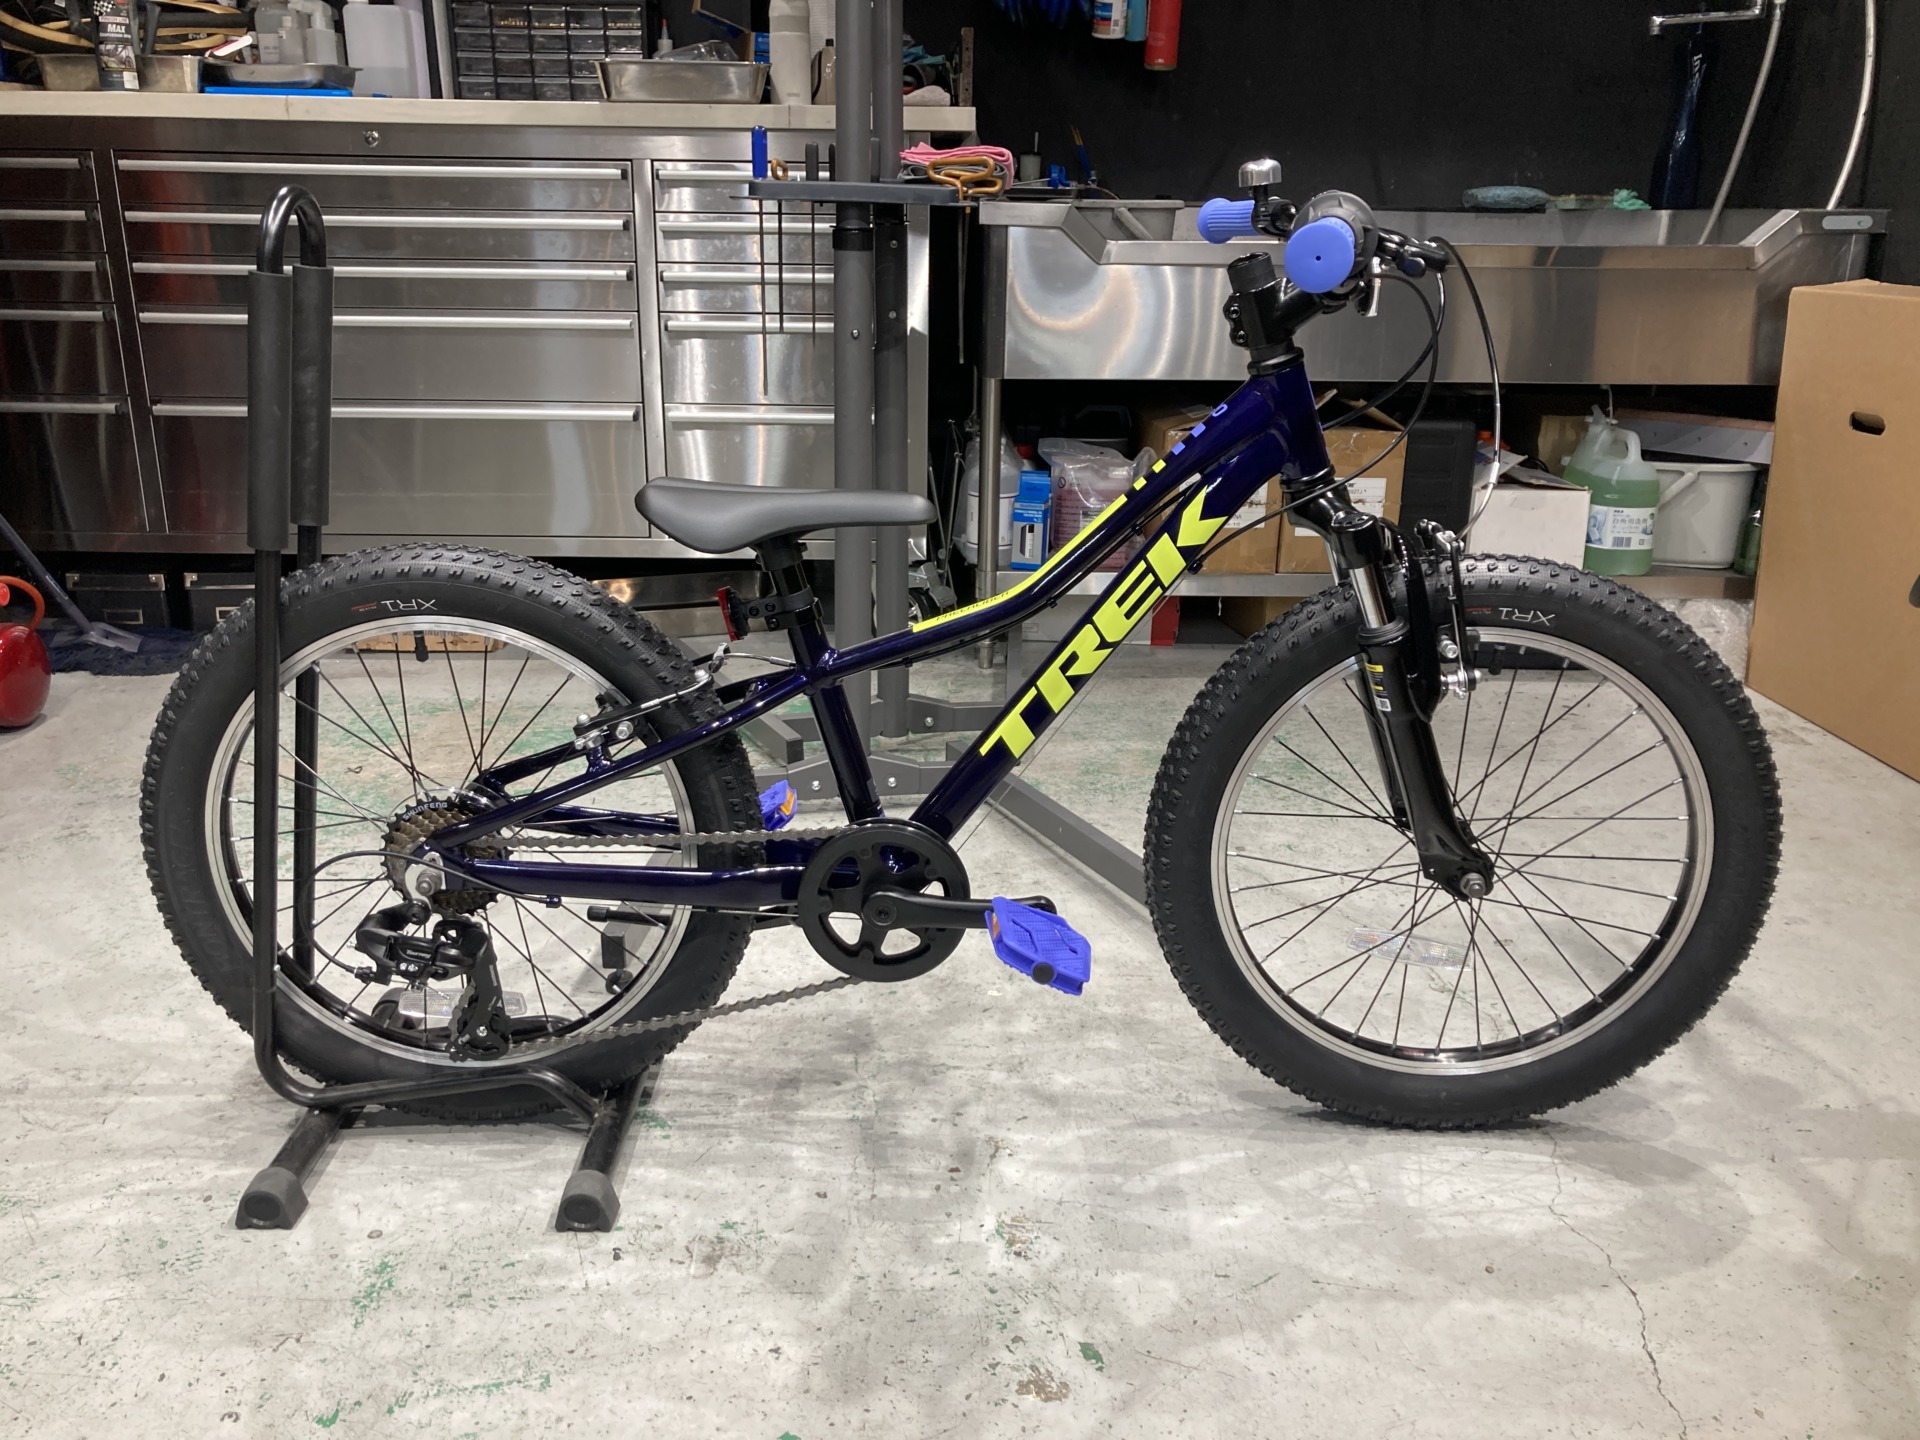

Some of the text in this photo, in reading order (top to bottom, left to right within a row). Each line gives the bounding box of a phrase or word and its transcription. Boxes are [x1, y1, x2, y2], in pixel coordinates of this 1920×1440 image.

[381, 598, 438, 612] XR1
[979, 485, 1229, 759] TREK
[1498, 607, 1556, 626] XR1
[402, 801, 448, 821] SHUNFENG
